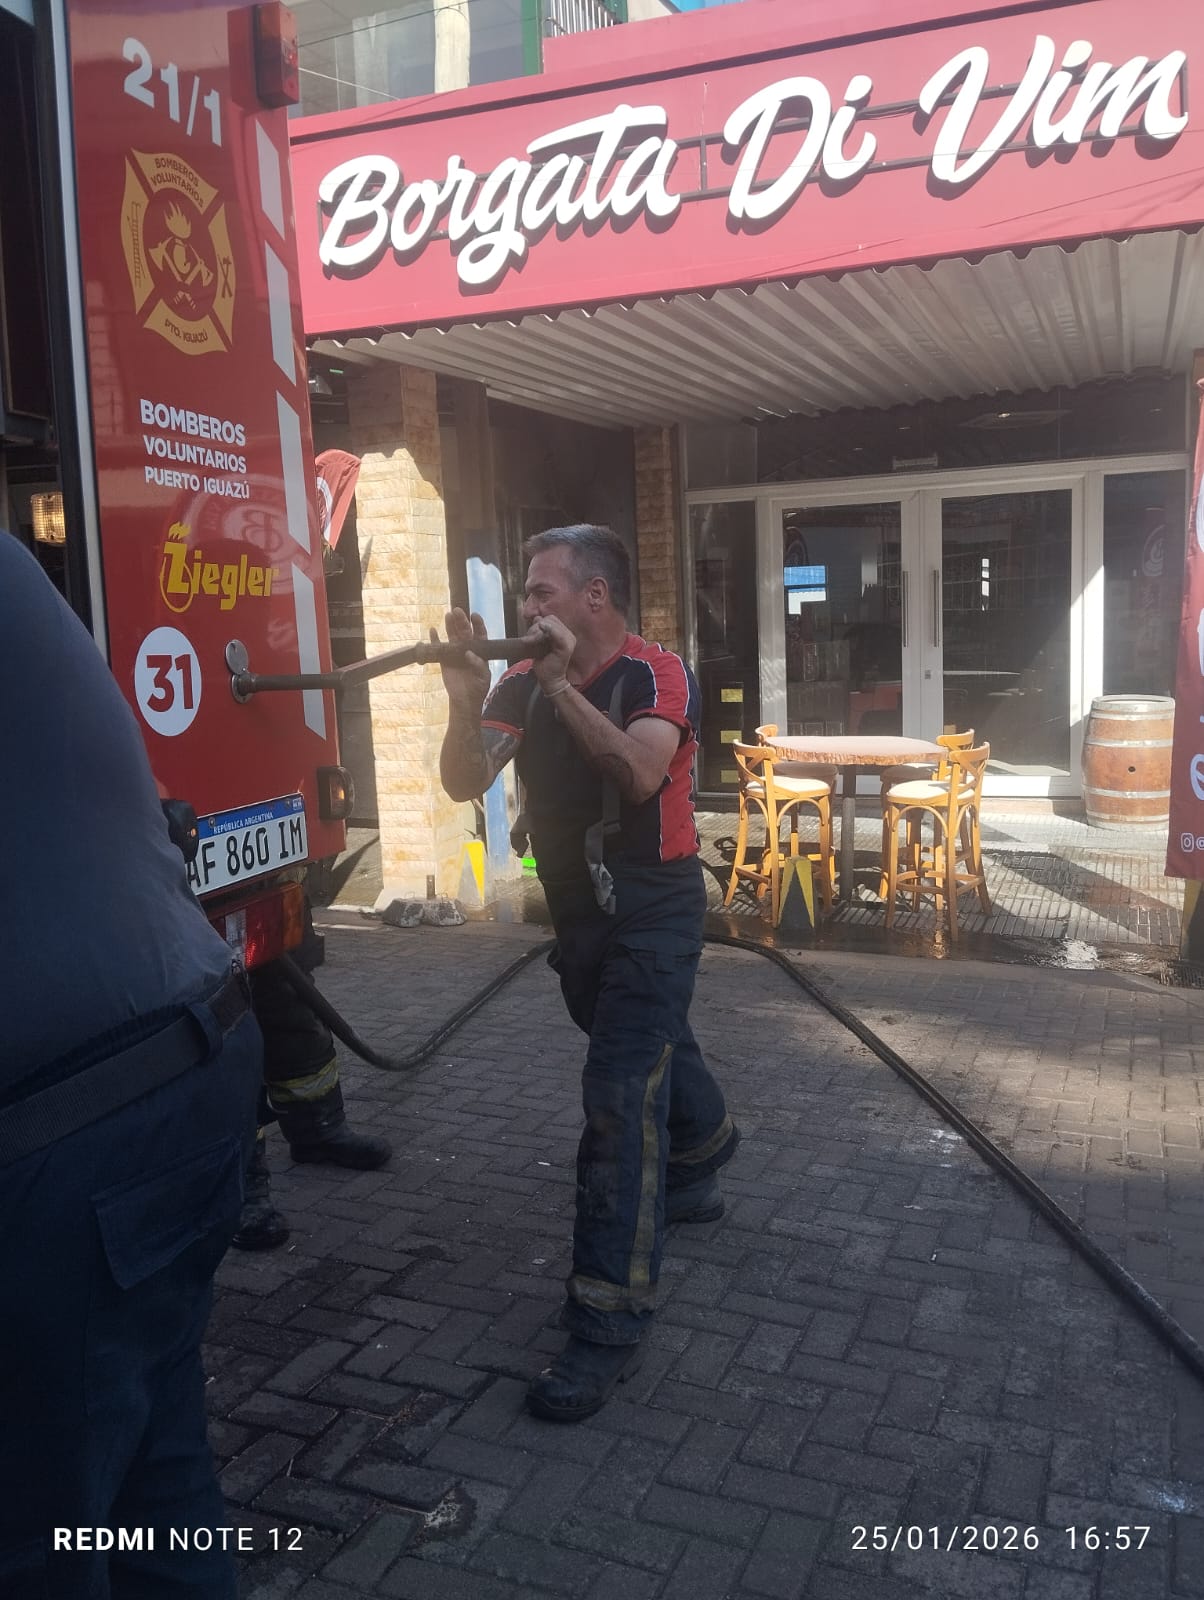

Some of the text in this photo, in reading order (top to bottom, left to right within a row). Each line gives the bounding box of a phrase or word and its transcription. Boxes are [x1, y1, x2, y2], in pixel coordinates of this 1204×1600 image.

[122, 37, 222, 147] 21/1
[154, 157, 200, 187] BOMBEROS
[318, 35, 1189, 285] Borgata Di Vim
[150, 172, 204, 209] VOLUNTARIOS
[164, 318, 209, 344] PTO. IGUAZÚ
[140, 399, 246, 447] BOMBEROS
[143, 434, 247, 474] VOLUNTARIOS
[145, 466, 250, 499] PUERTO IGUAZÚ
[160, 540, 280, 612] Ziegler
[146, 653, 194, 713] 31
[213, 811, 274, 835] REPÚBLICA ARGENTINA
[185, 816, 304, 888] AF 860 IM
